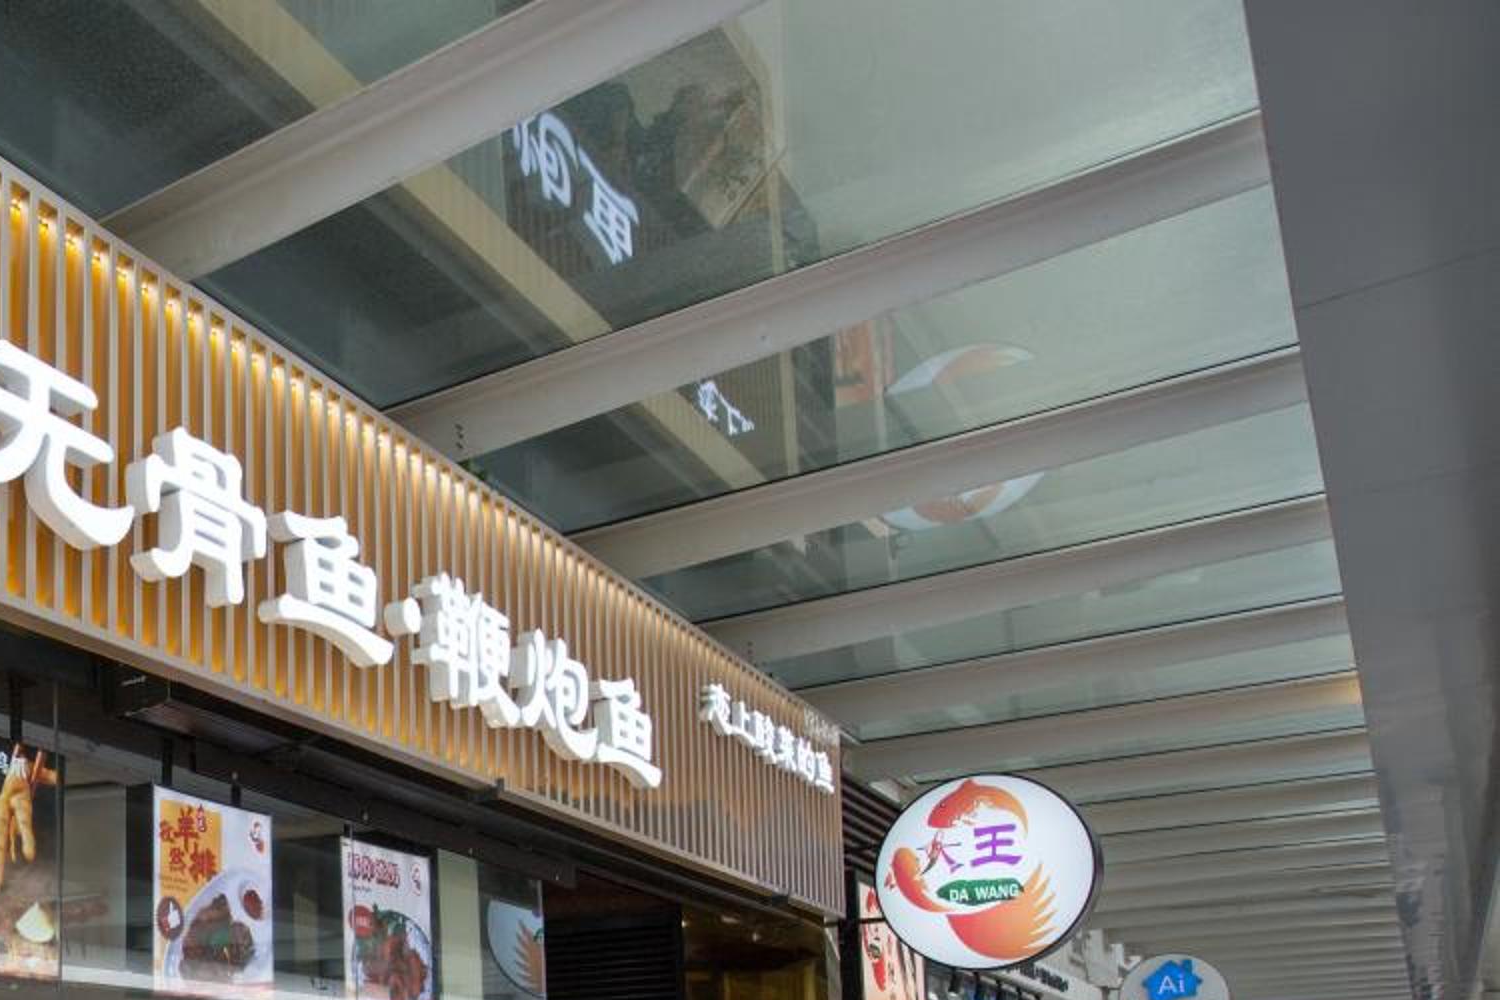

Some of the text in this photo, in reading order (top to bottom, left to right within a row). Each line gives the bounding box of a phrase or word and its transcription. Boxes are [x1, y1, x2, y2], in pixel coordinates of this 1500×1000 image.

[916, 823, 1022, 875] 大王
[949, 883, 1019, 901] DA WANG
[1158, 972, 1186, 995] Ai
